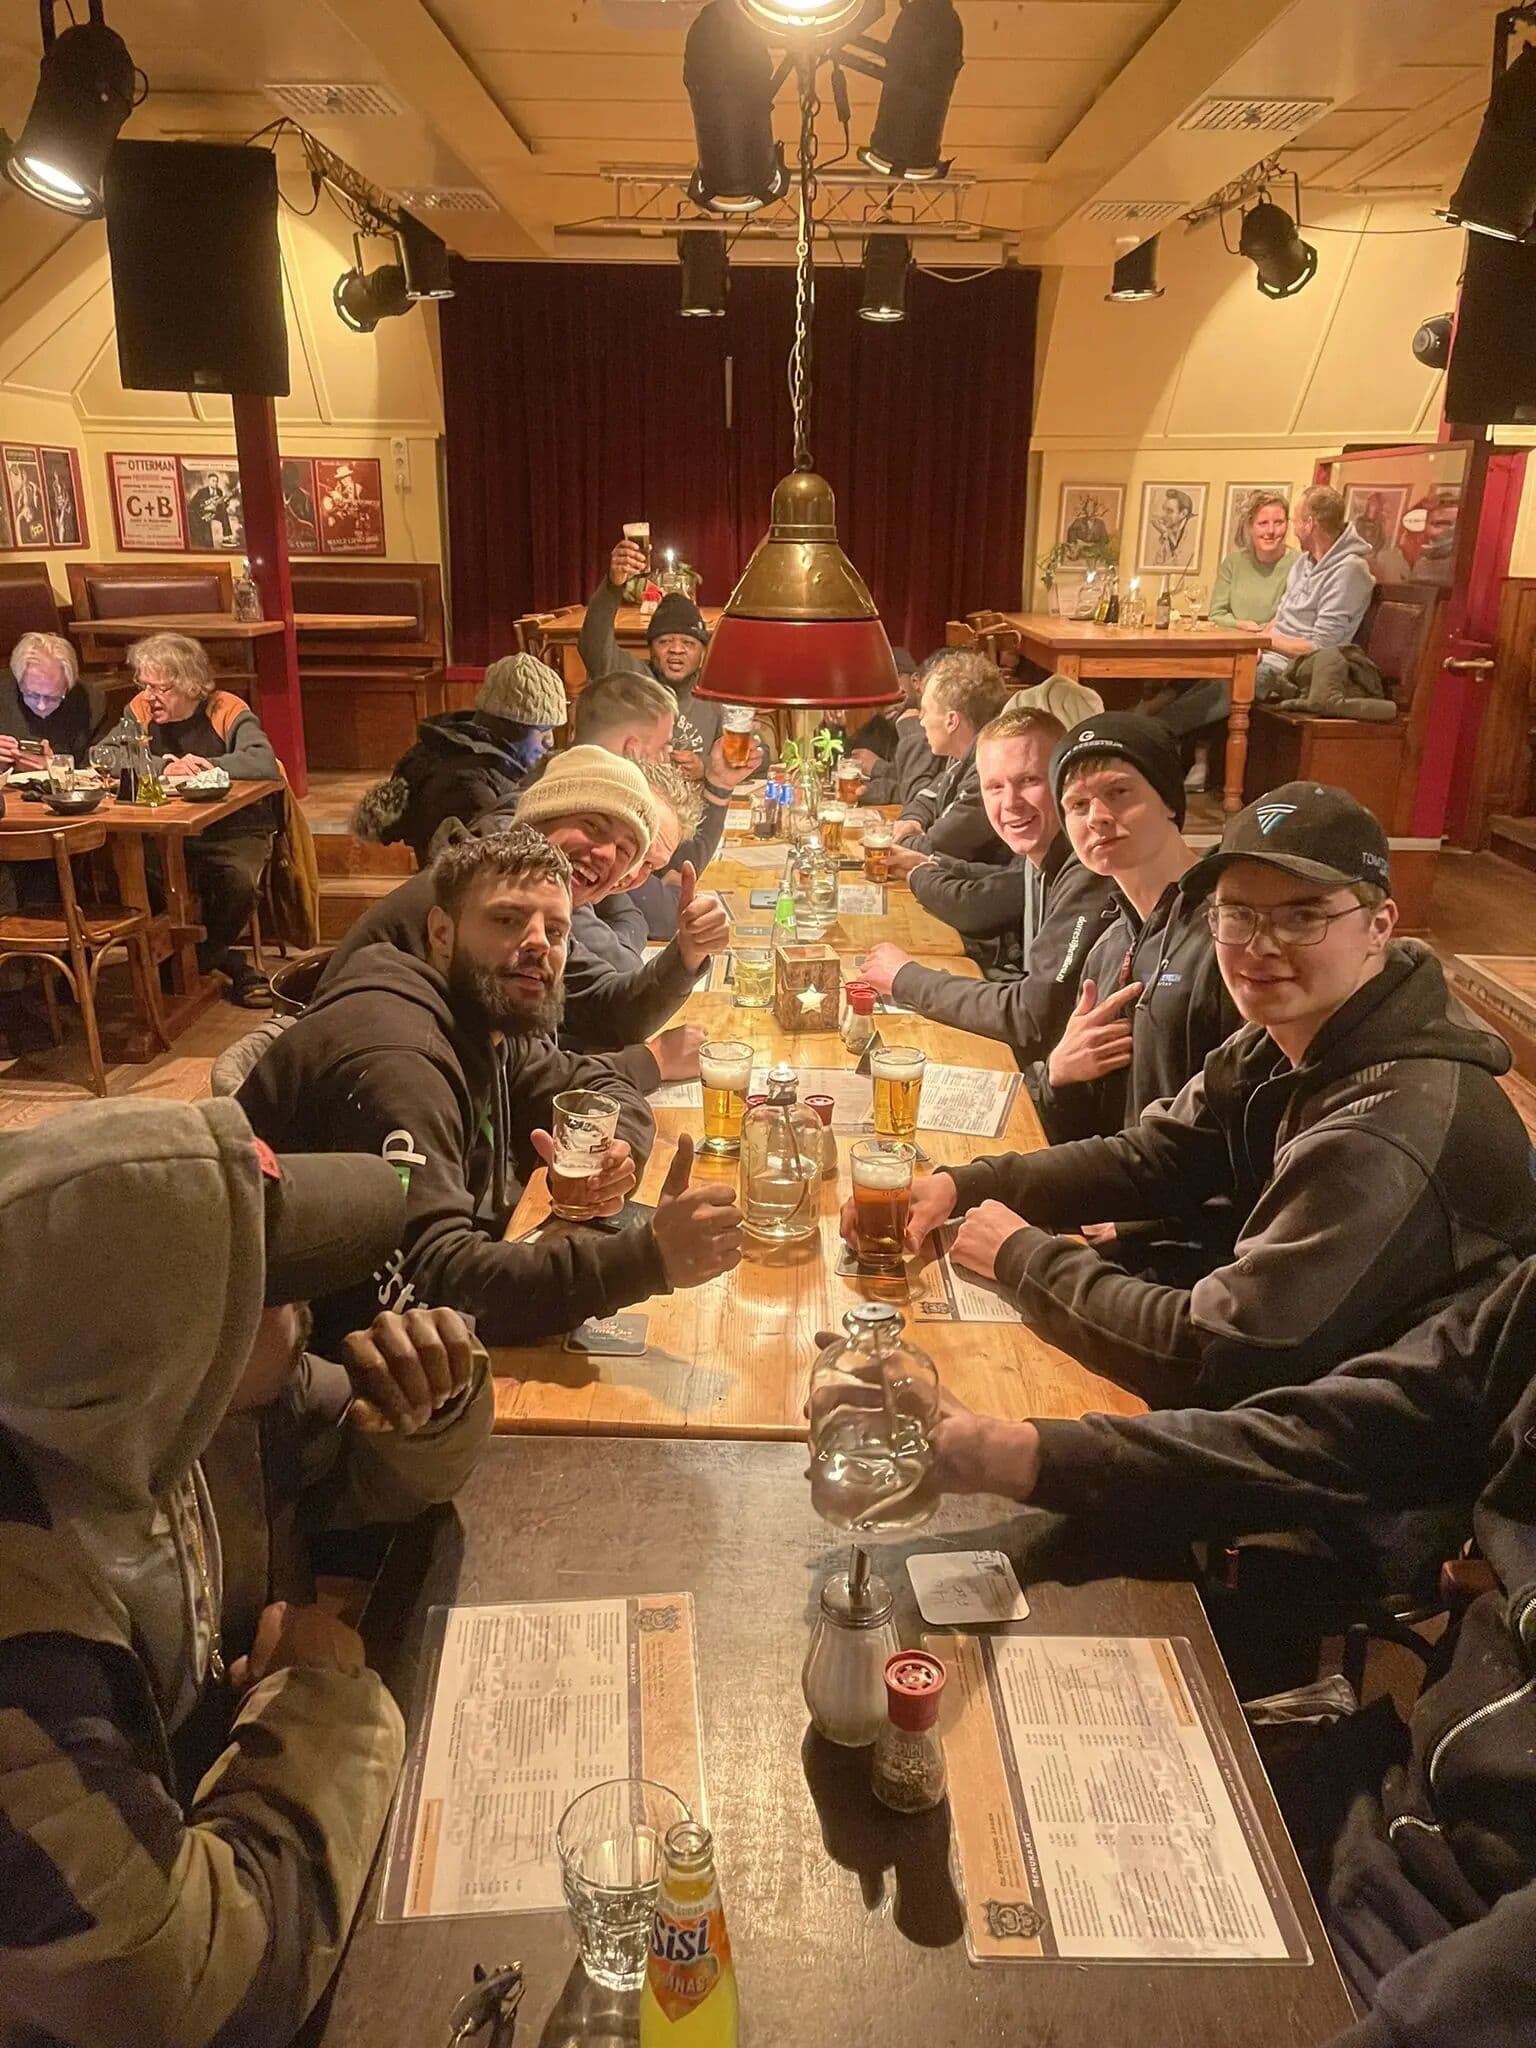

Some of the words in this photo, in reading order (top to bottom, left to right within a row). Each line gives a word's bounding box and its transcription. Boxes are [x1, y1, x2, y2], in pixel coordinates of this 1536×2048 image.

[128, 459, 175, 472] OTTERMAN
[1022, 1830, 1040, 1889] MENUKAART
[651, 1911, 711, 1962] Sisi
